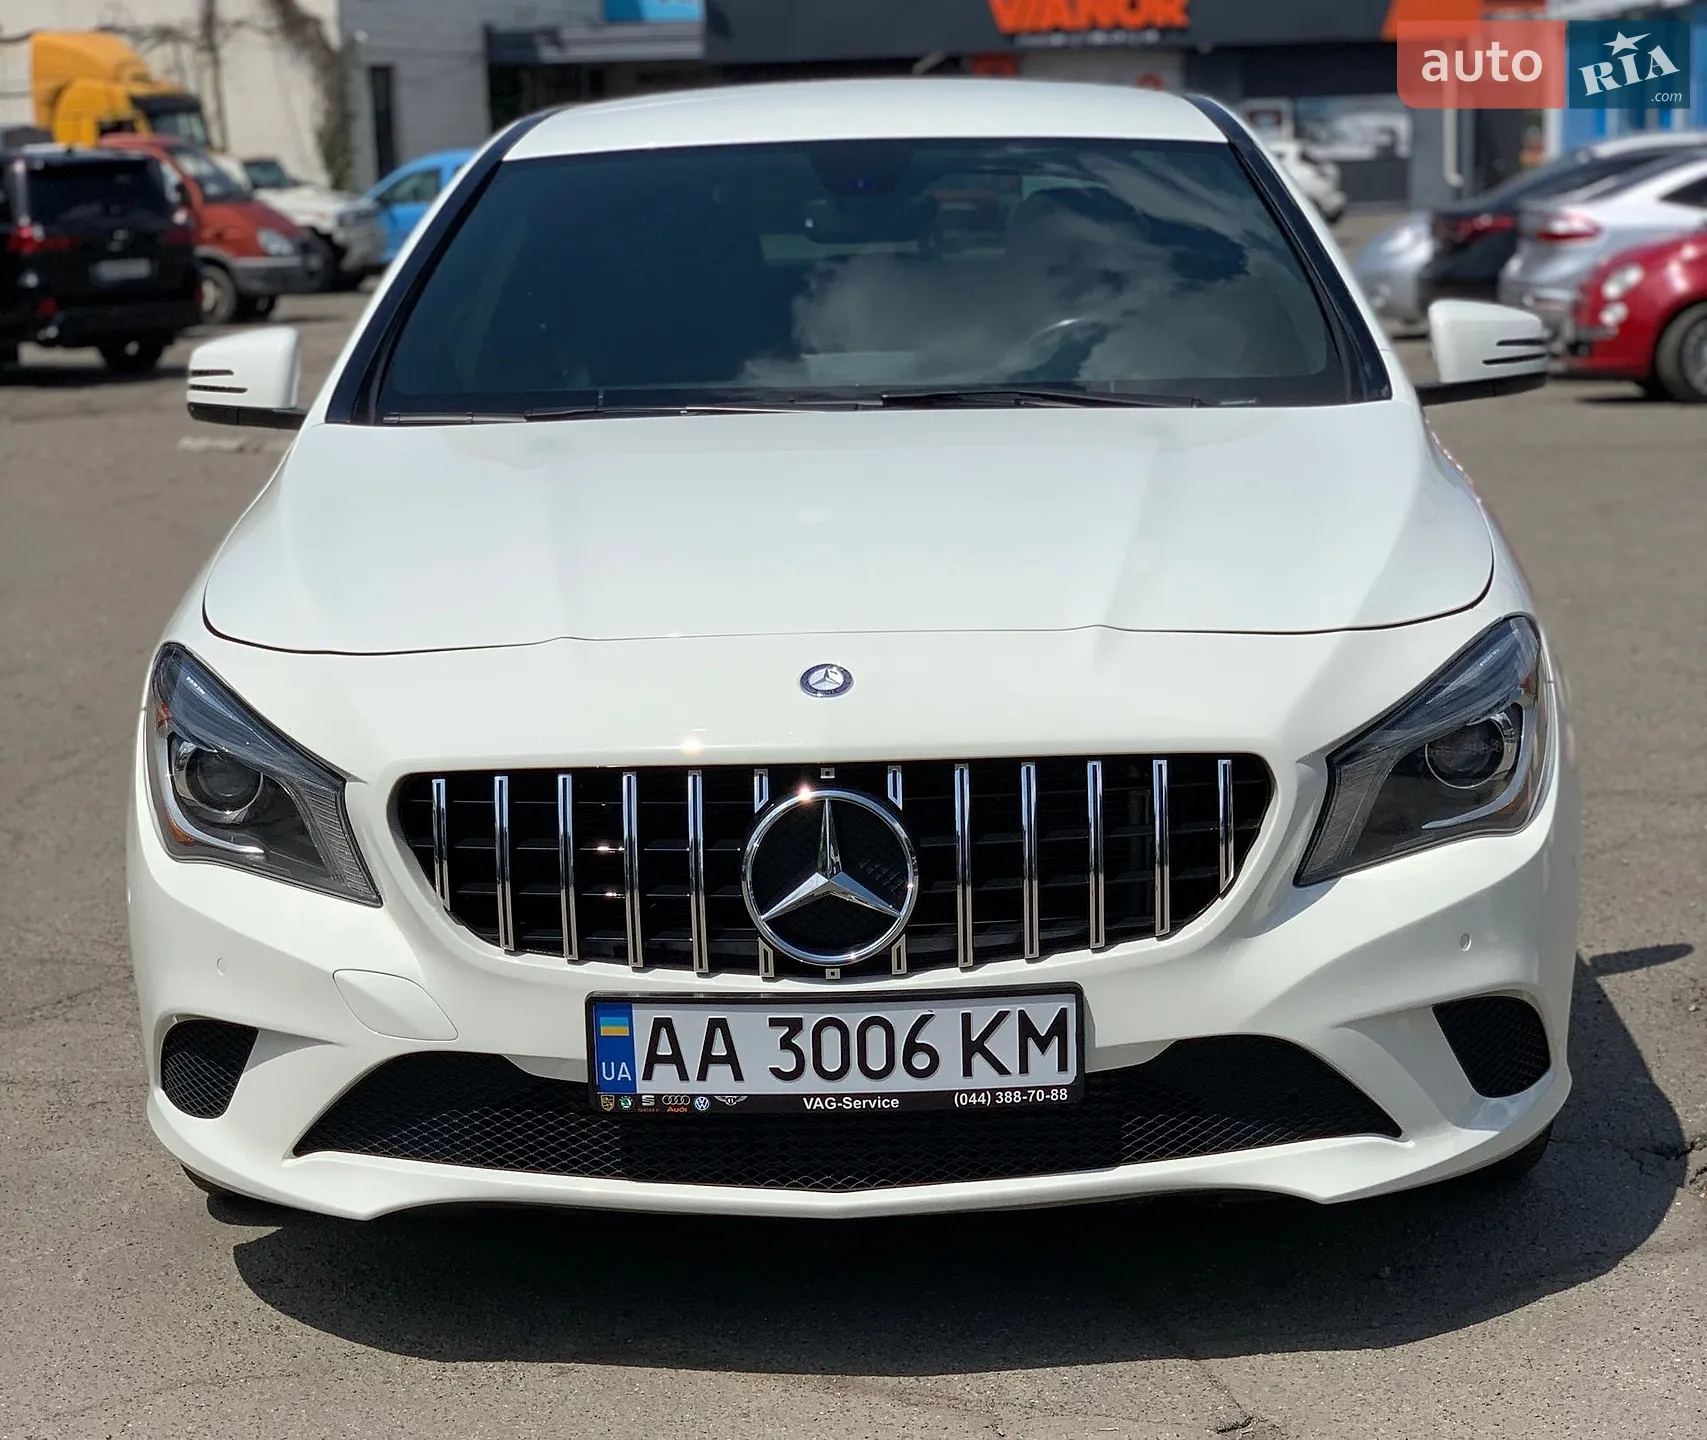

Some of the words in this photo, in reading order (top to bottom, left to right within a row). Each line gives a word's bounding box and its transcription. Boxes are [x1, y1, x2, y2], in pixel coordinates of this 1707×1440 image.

[642, 1016, 744, 1082] AA
[768, 1013, 940, 1082] 3006
[961, 1007, 1068, 1078] KM
[602, 1061, 632, 1081] UA
[802, 1096, 900, 1110] VAG-Service
[954, 1090, 992, 1108] (044)
[995, 1088, 1068, 1104] 388-70-88
